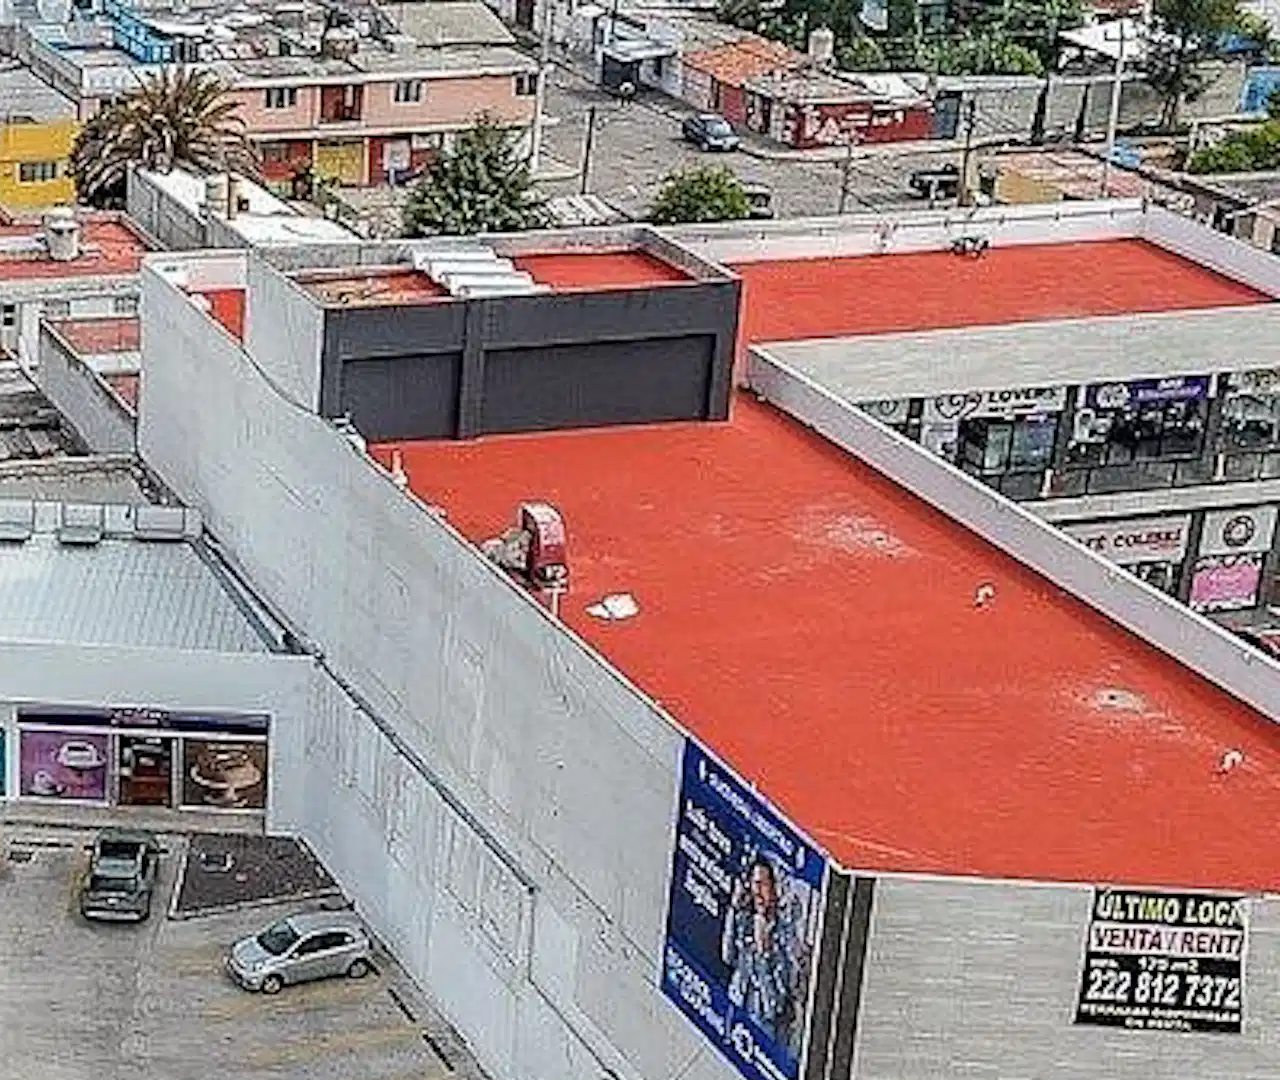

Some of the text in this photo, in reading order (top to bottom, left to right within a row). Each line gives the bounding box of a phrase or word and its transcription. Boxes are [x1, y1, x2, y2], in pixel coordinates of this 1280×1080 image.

[1096, 888, 1180, 923] ÚLTIMO
[1095, 927, 1161, 951] VENTA
[1180, 931, 1243, 955] RENT
[1087, 968, 1241, 1009] 222 812 7372
